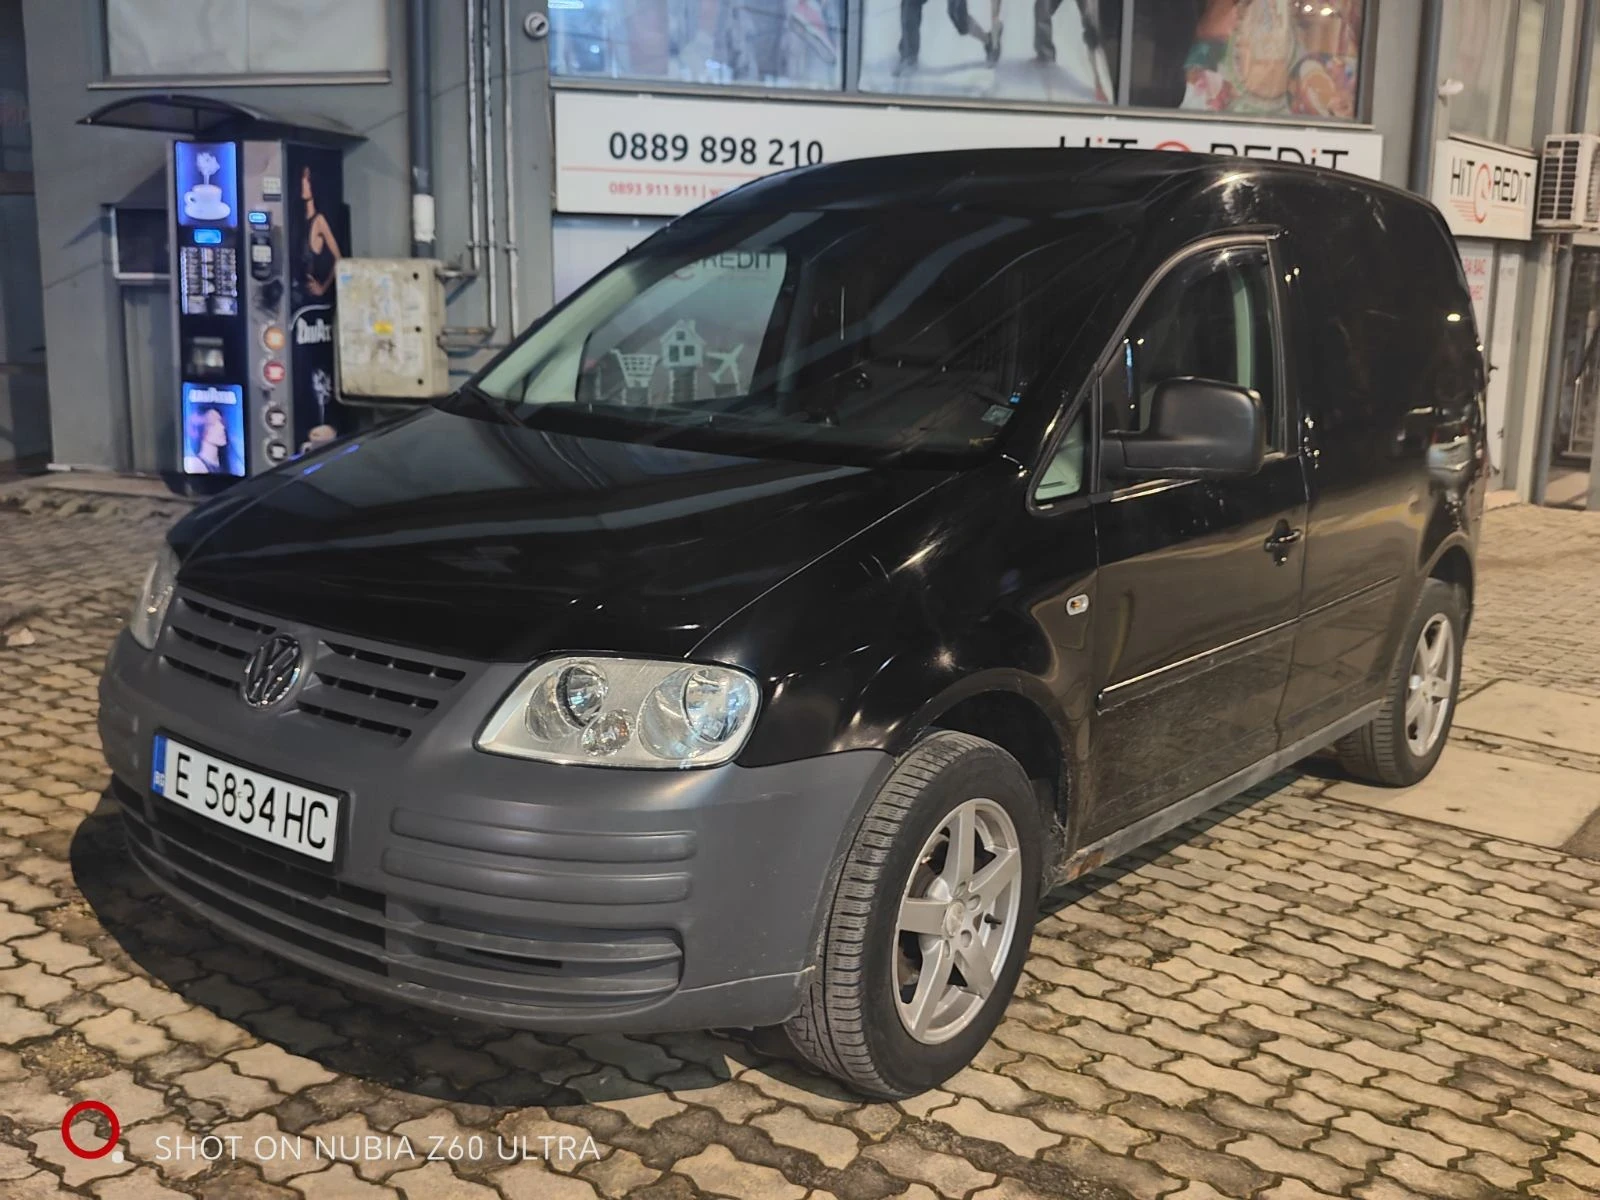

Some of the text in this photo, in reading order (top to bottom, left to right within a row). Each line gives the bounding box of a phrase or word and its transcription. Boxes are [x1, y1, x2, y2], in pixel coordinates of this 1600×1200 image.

[609, 131, 824, 167] 0889 898 210
[608, 181, 642, 196] 0893
[646, 182, 669, 197] 911
[674, 183, 697, 198] 911
[175, 752, 191, 800] E
